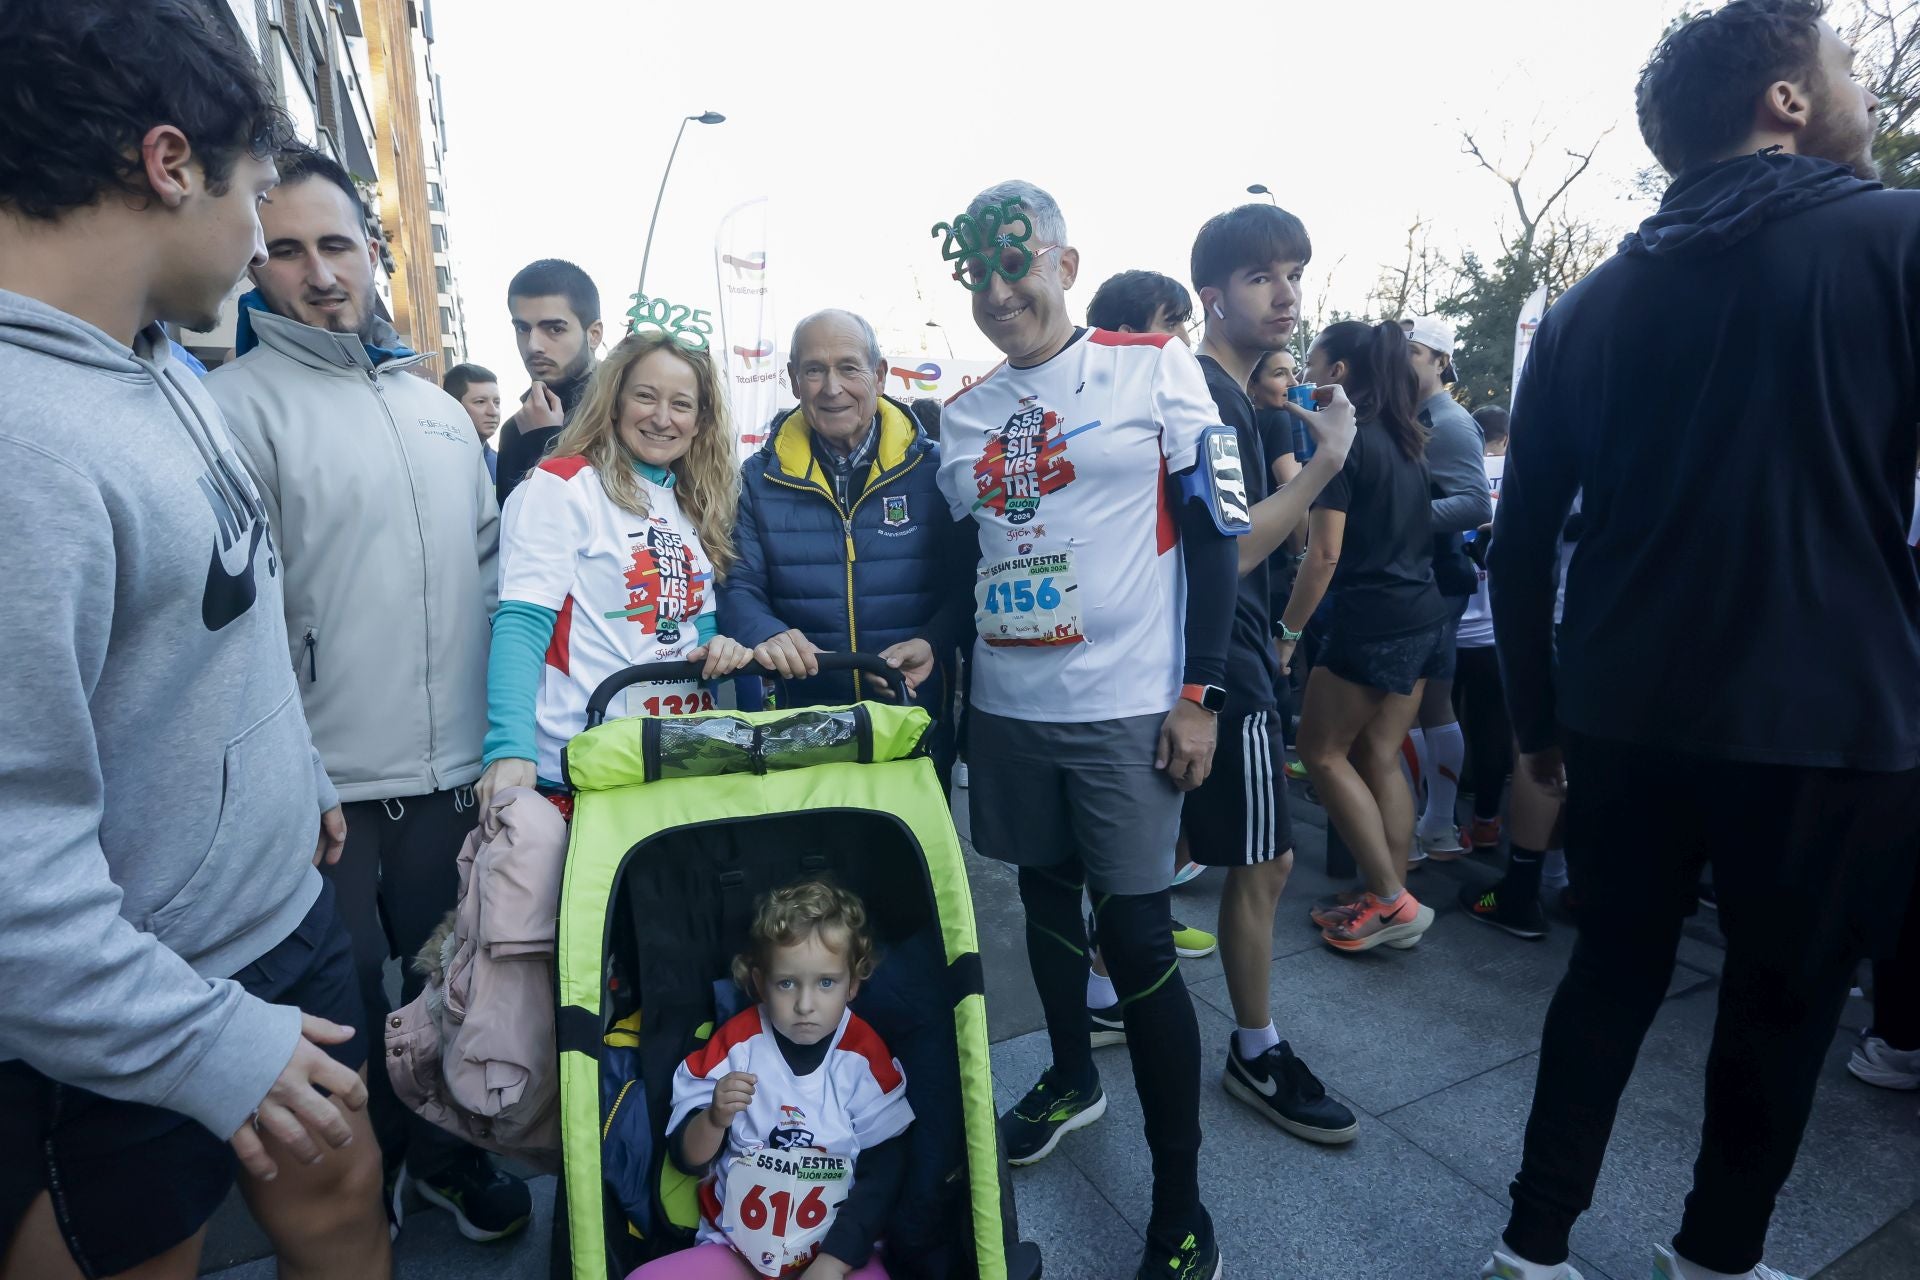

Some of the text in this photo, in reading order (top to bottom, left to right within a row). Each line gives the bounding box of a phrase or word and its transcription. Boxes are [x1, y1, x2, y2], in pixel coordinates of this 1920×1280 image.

[930, 195, 1032, 262] 2025
[626, 292, 713, 335] 2025
[1021, 408, 1043, 428] 55
[1007, 424, 1041, 439] SAN
[1006, 436, 1037, 458] SIL
[1004, 453, 1037, 476] VES
[1001, 472, 1041, 497] TRE
[1013, 512, 1031, 521] 2024
[662, 532, 682, 548] 55
[1006, 527, 1031, 541] gijón
[654, 538, 686, 562] SAN
[659, 556, 687, 578] SIL
[998, 561, 1011, 571] SAN
[1012, 553, 1067, 569] SILVESTRE
[1050, 564, 1067, 573] 2024
[660, 576, 688, 598] VES
[984, 576, 1061, 614] 4156
[643, 691, 714, 716] 1328
[757, 1154, 774, 1171] 55
[797, 1171, 843, 1180] GIJÓN 2024
[740, 1184, 828, 1238] 616
